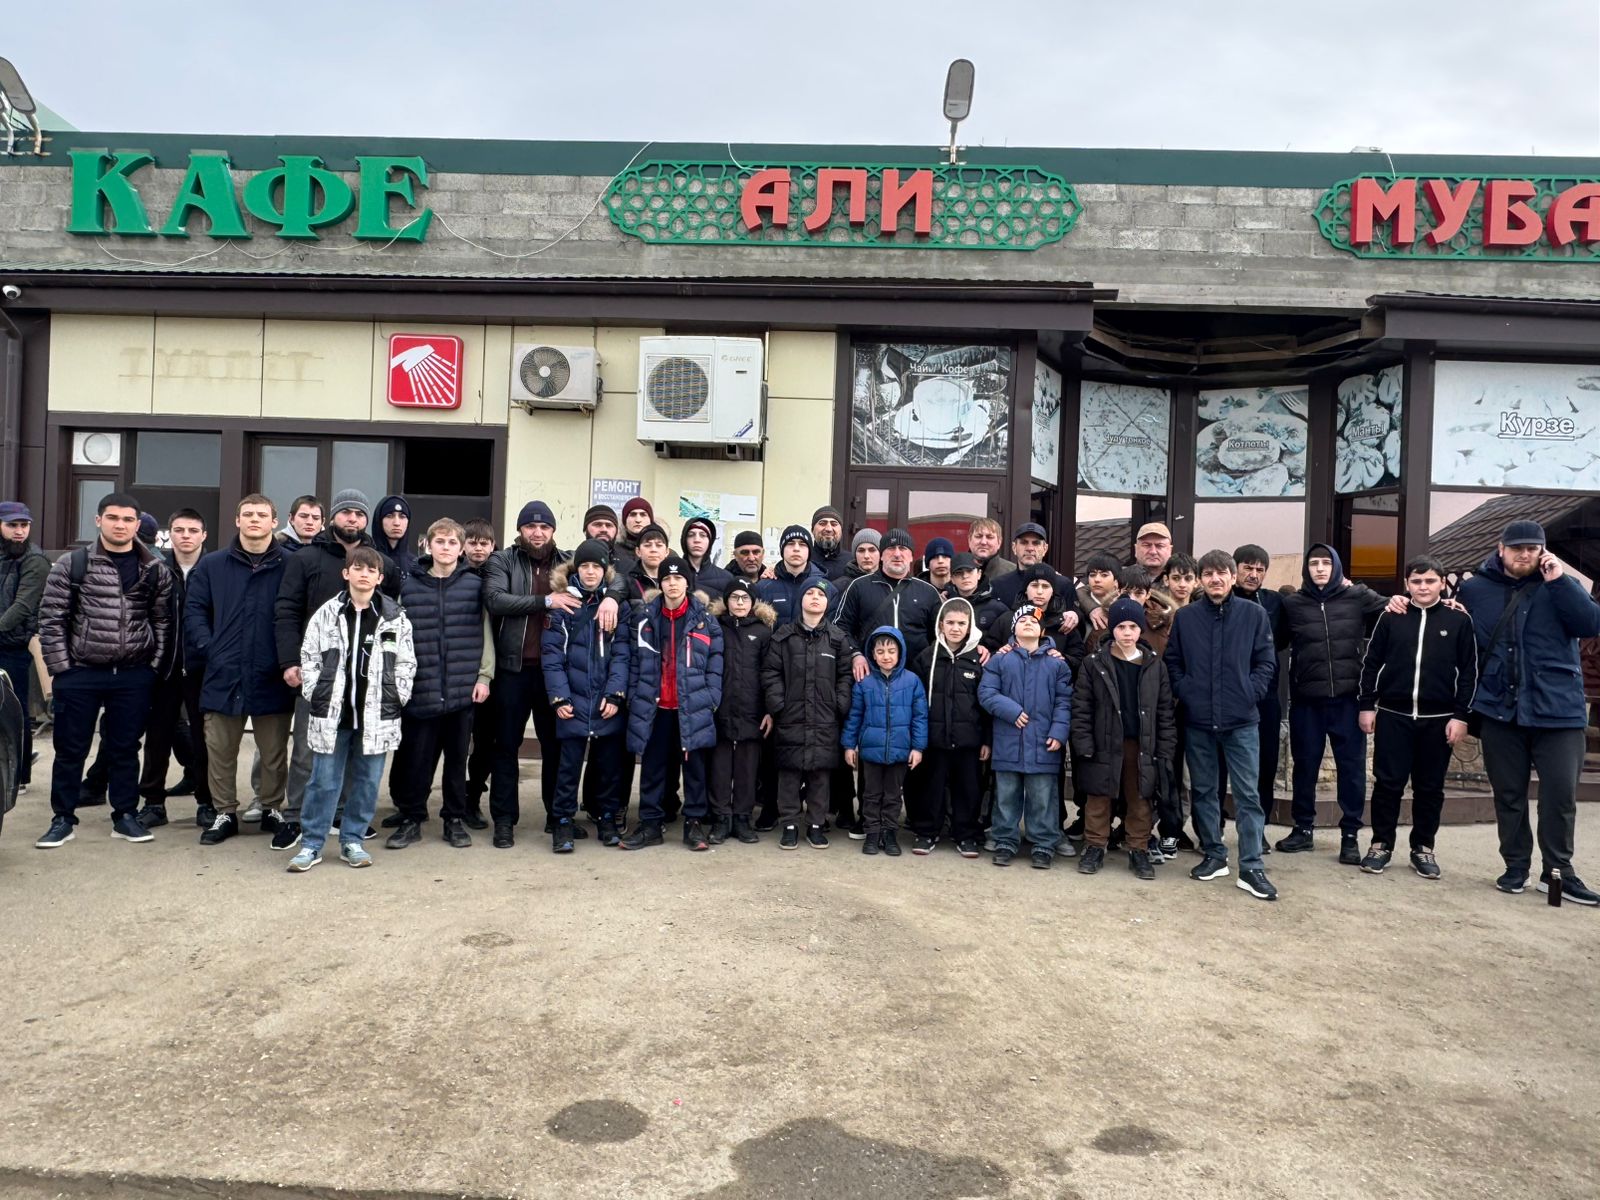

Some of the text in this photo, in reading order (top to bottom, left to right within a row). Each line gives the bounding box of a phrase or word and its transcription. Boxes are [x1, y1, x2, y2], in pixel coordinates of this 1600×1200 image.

[66, 148, 433, 242] КАФЕ
[740, 168, 934, 235] АЛИ
[1350, 178, 1600, 248] МУБА
[909, 362, 928, 373] Чай
[941, 363, 968, 375] Кофе
[1351, 423, 1386, 437] Манты
[1500, 411, 1574, 437] Курзе
[595, 481, 639, 493] РЕМОНТ
